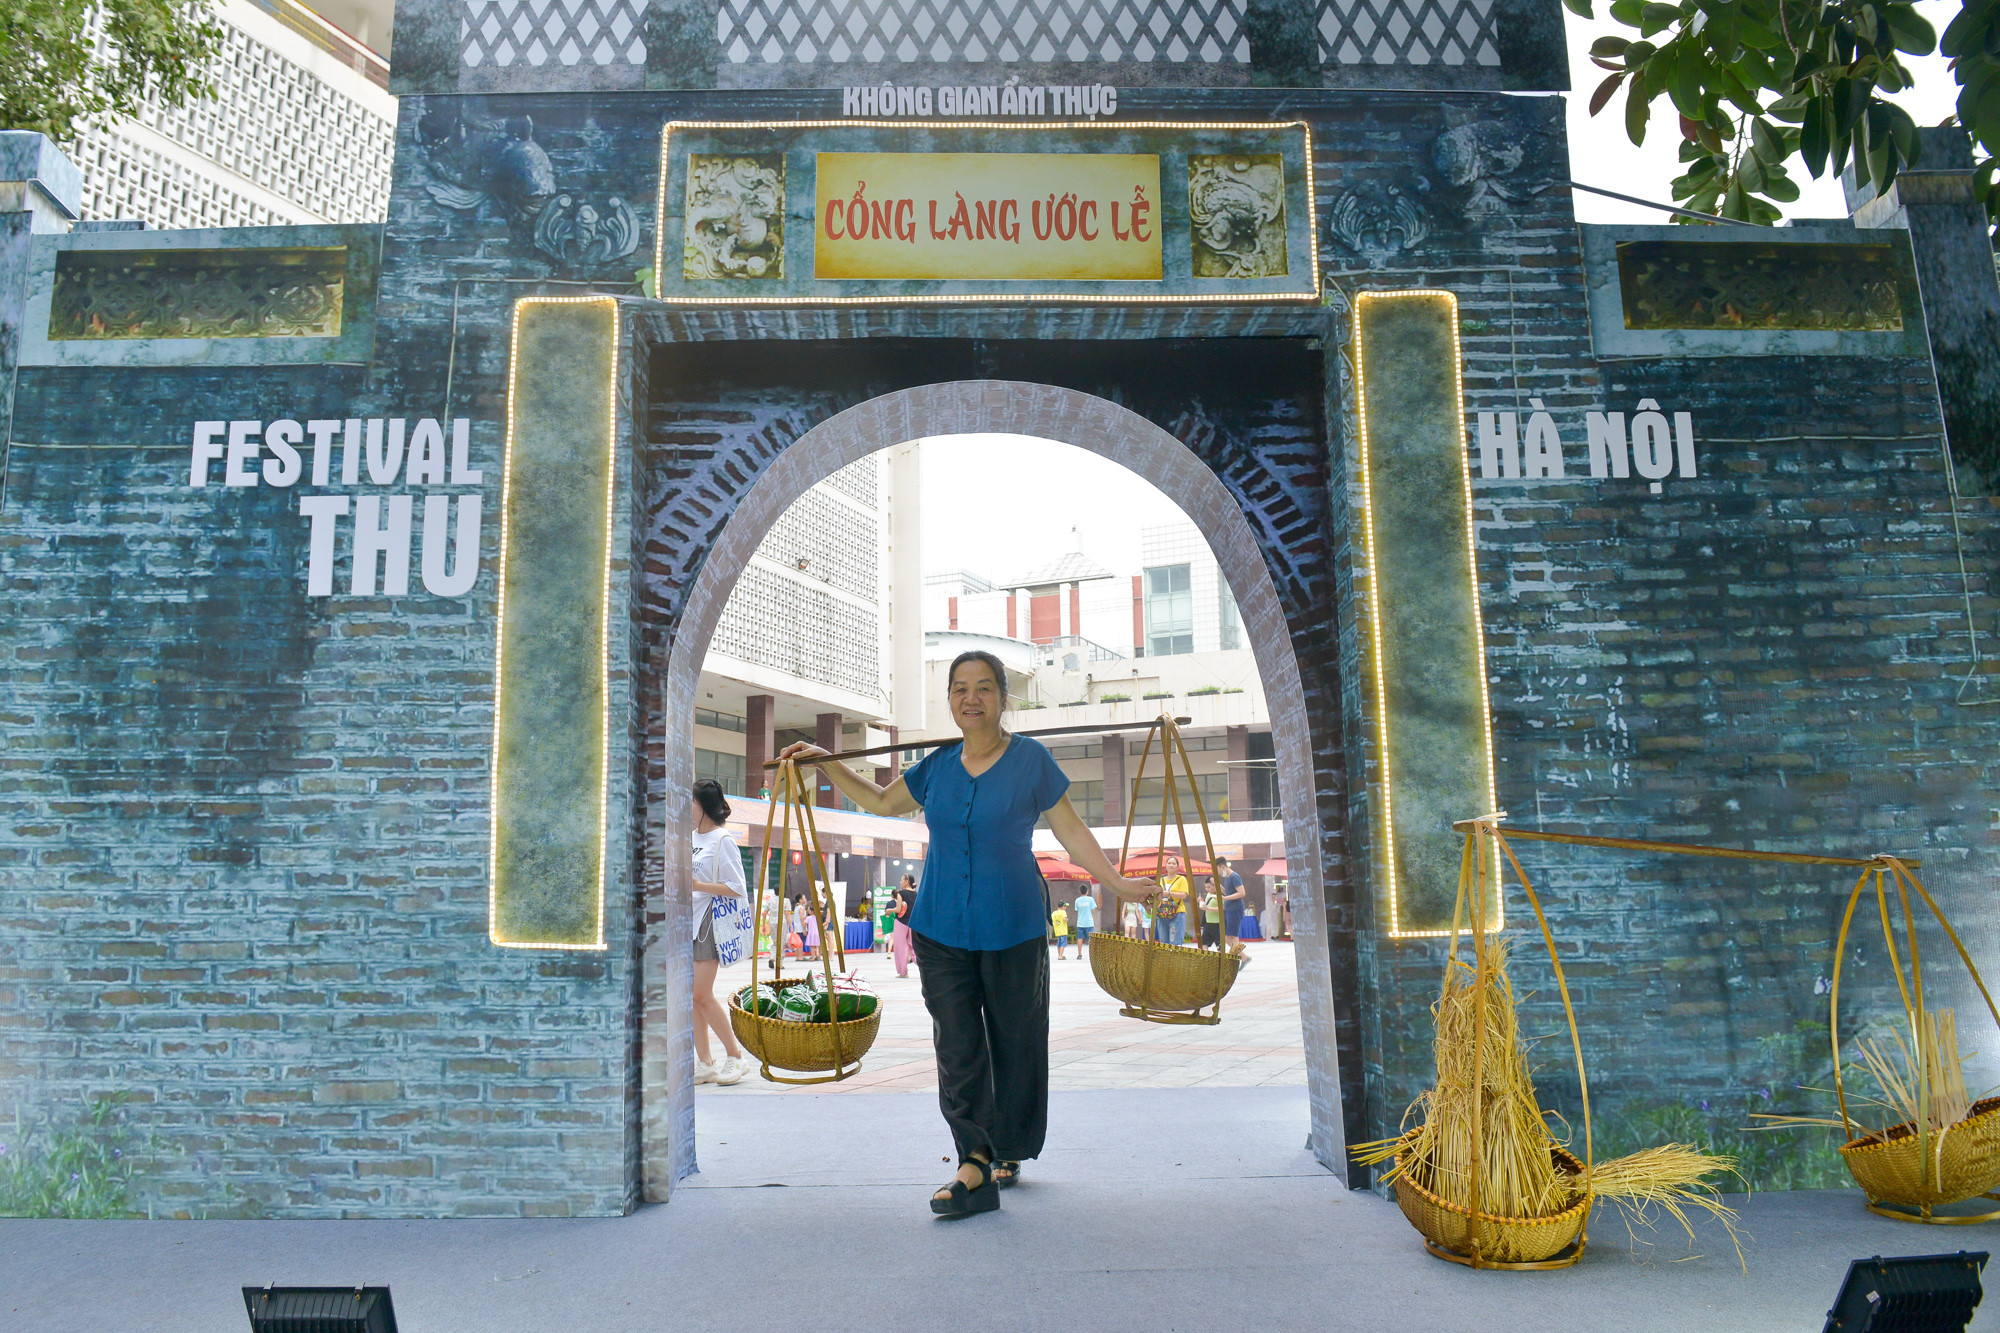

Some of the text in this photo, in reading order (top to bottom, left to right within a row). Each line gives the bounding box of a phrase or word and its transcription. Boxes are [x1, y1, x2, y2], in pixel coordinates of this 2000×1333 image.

[843, 76, 1117, 121] KHÔNG GIAN ẨM THỰC
[824, 180, 1152, 245] CỔNG LÀNG ƯỚC LỄ
[189, 418, 483, 488] FESTIVAL
[1478, 398, 1697, 494] HÀ NỘI
[299, 495, 482, 597] THU
